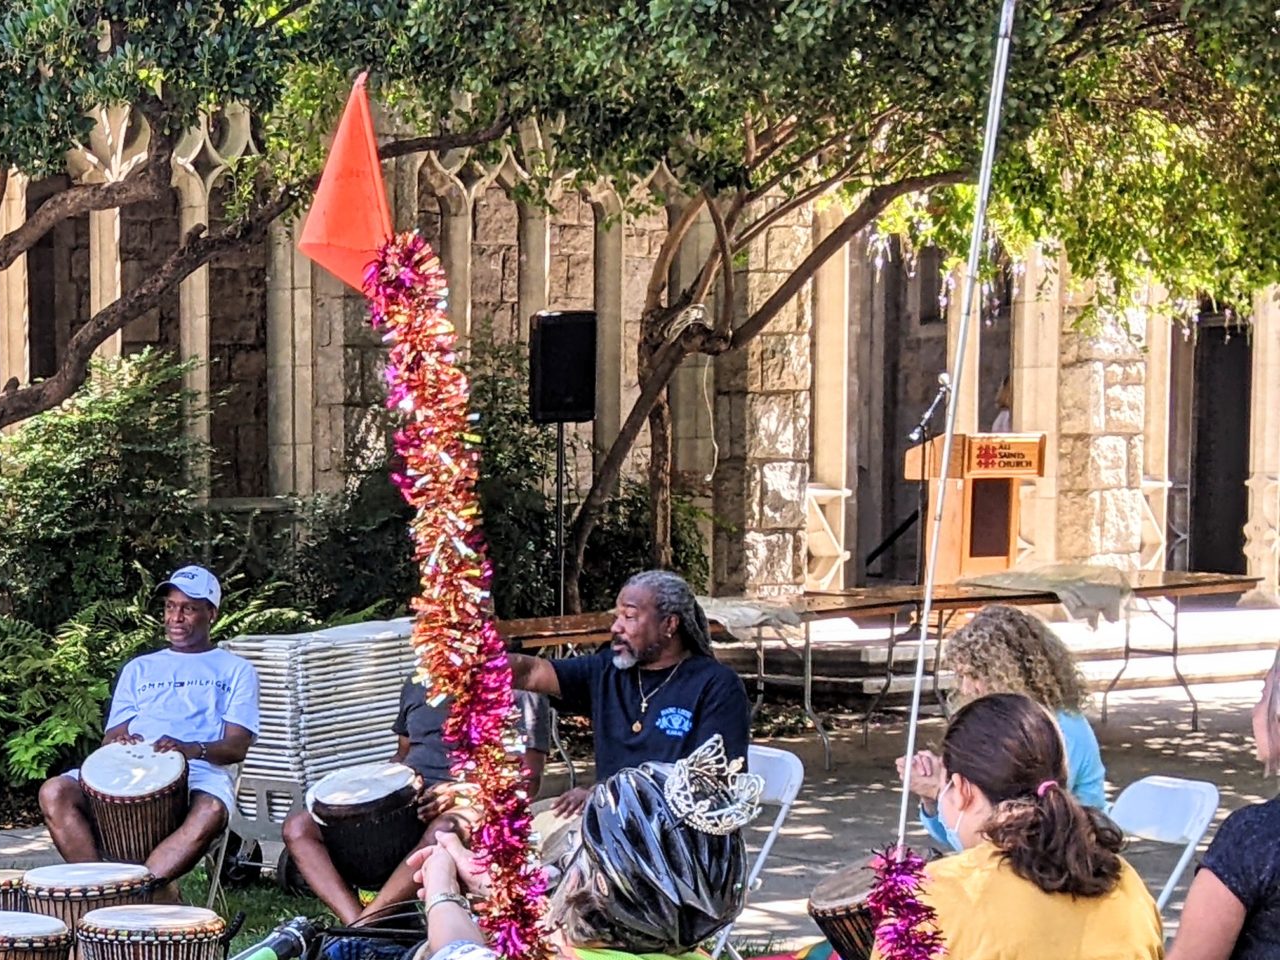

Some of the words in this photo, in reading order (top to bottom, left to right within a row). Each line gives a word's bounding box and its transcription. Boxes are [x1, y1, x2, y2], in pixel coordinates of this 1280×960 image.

[998, 460, 1032, 468] CHURCH
[136, 681, 172, 695] TOMMY
[186, 680, 232, 694] HILFIGER
